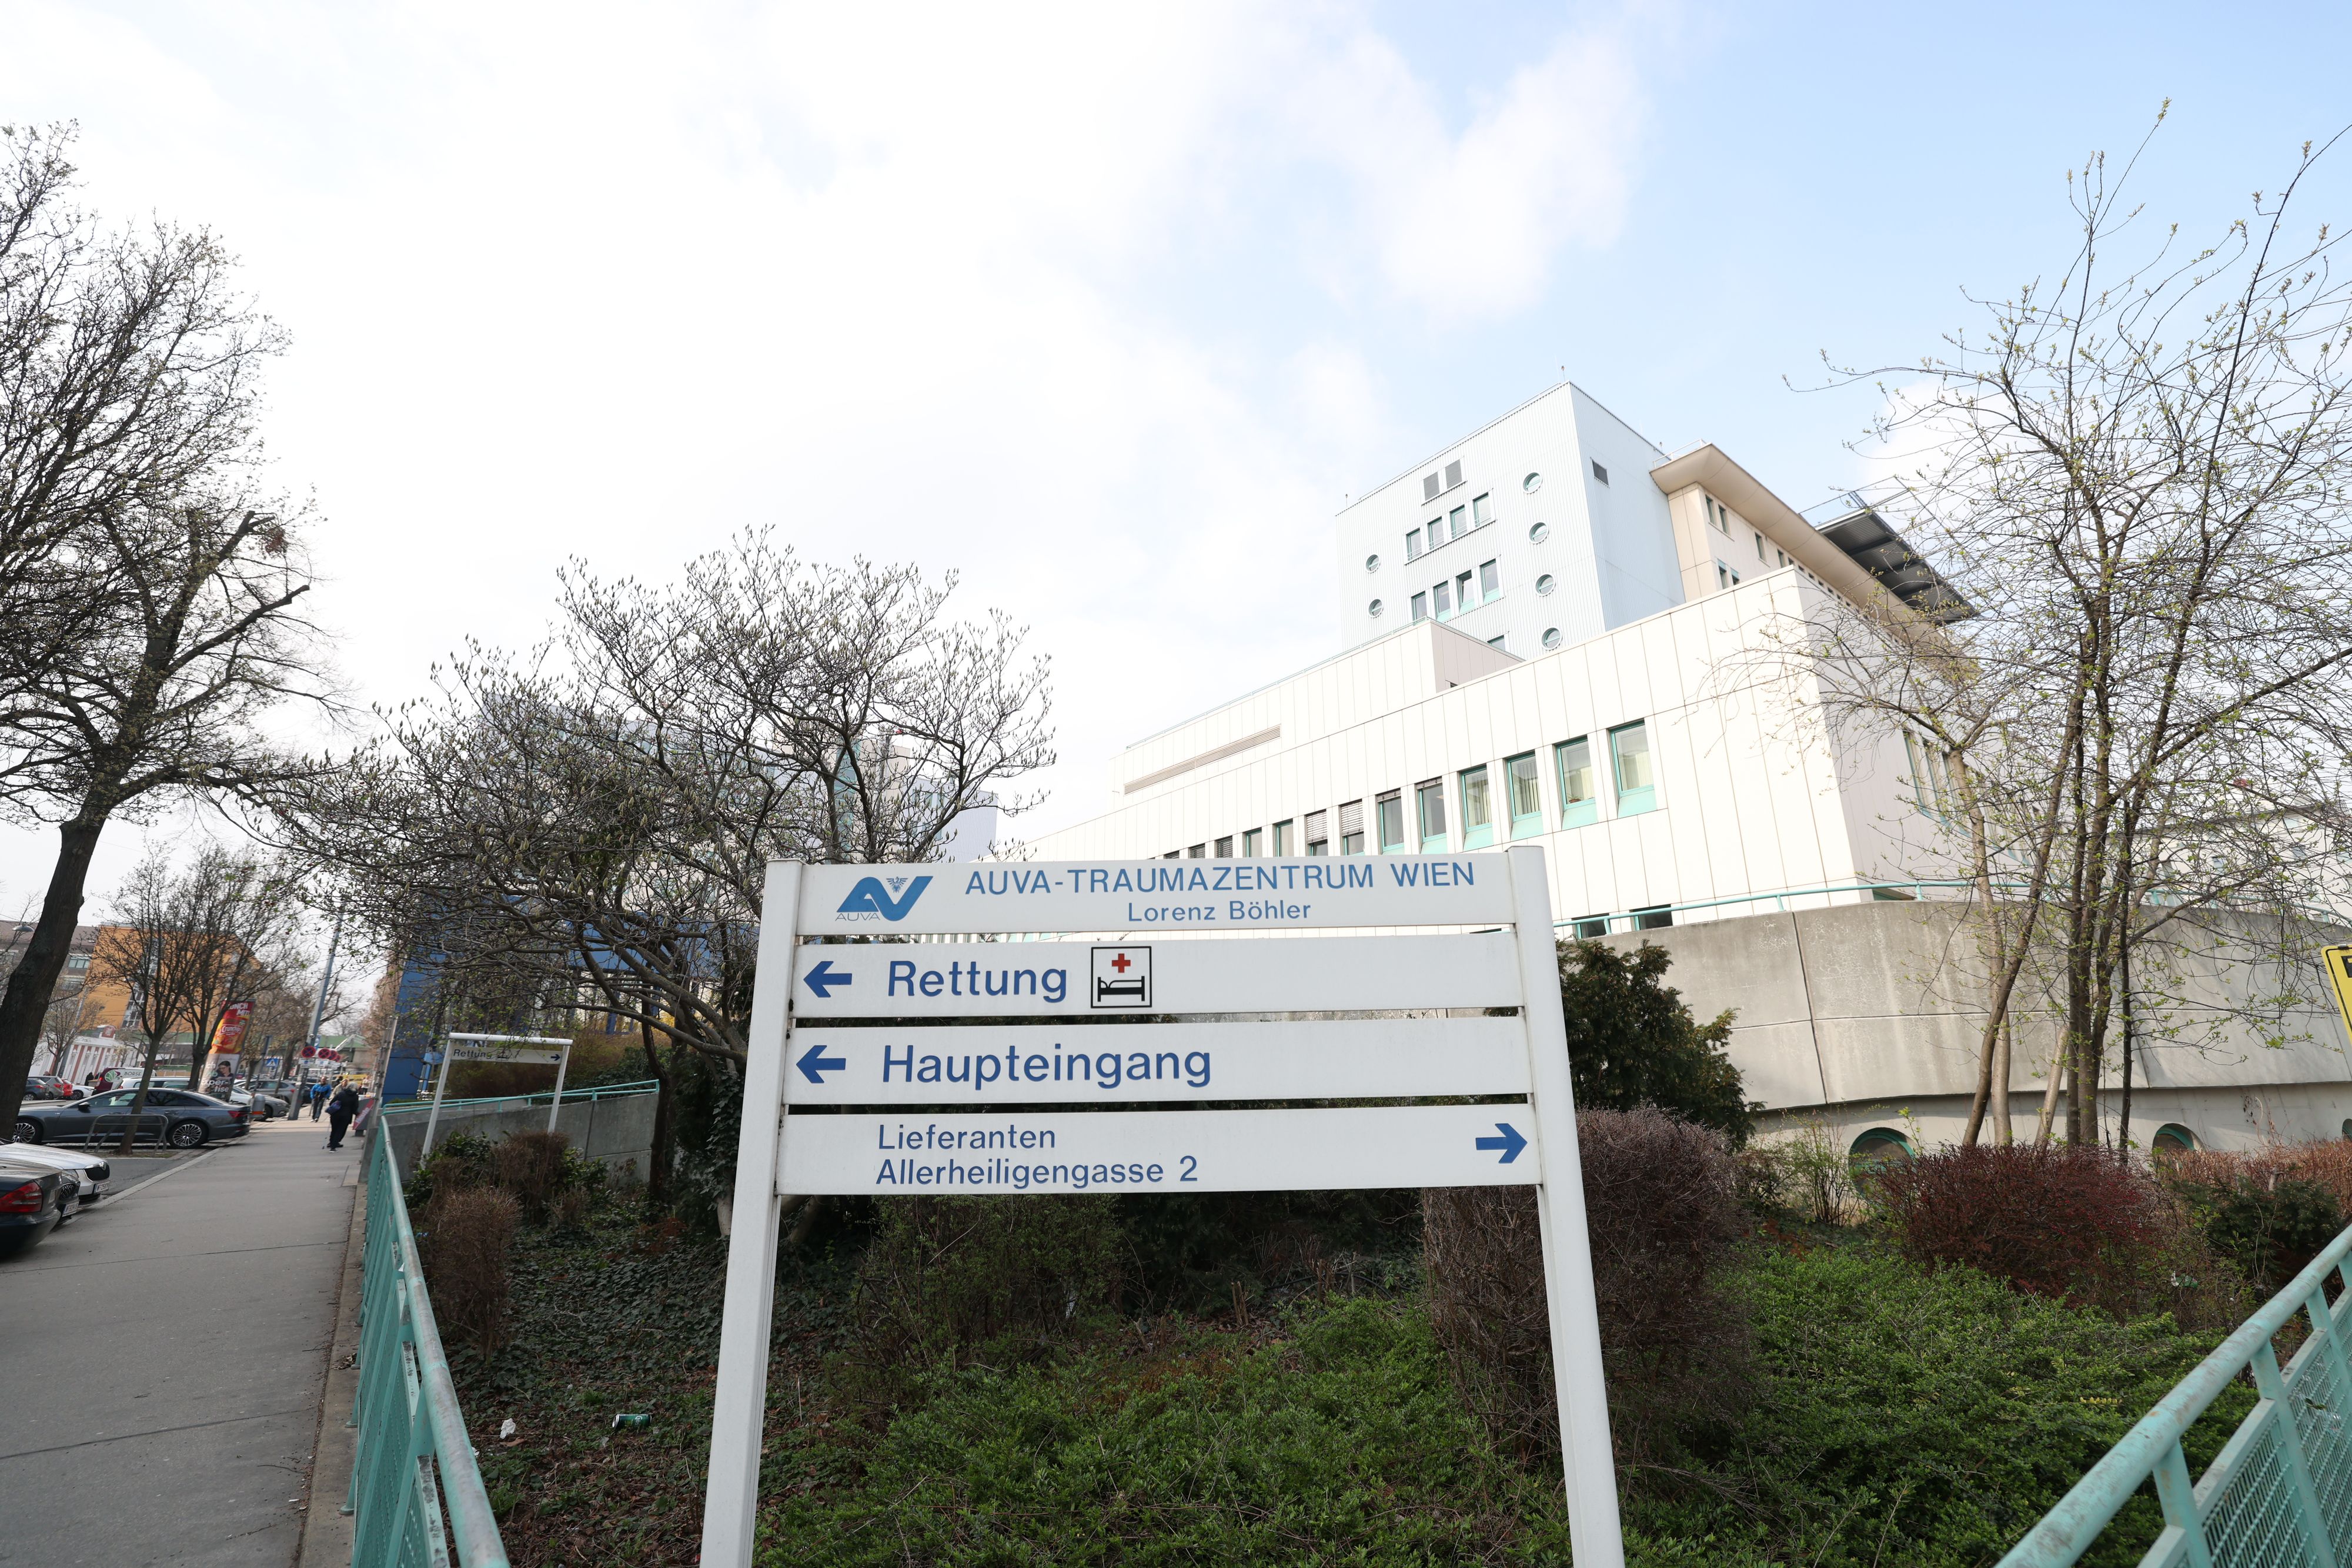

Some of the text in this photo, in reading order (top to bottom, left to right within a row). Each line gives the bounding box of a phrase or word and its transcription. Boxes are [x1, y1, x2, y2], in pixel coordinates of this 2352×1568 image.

[965, 861, 1475, 895] AUVA-TRAUMAZENTRUM WIEN
[834, 912, 880, 921] AUVA
[1128, 900, 1311, 922] Lorenz Böhler
[887, 960, 1067, 1003] Rettung
[883, 1043, 1211, 1092] Haupteingang
[878, 1124, 1055, 1150] Lieferanten
[876, 1155, 1198, 1190] Allerheiligengasse 2
